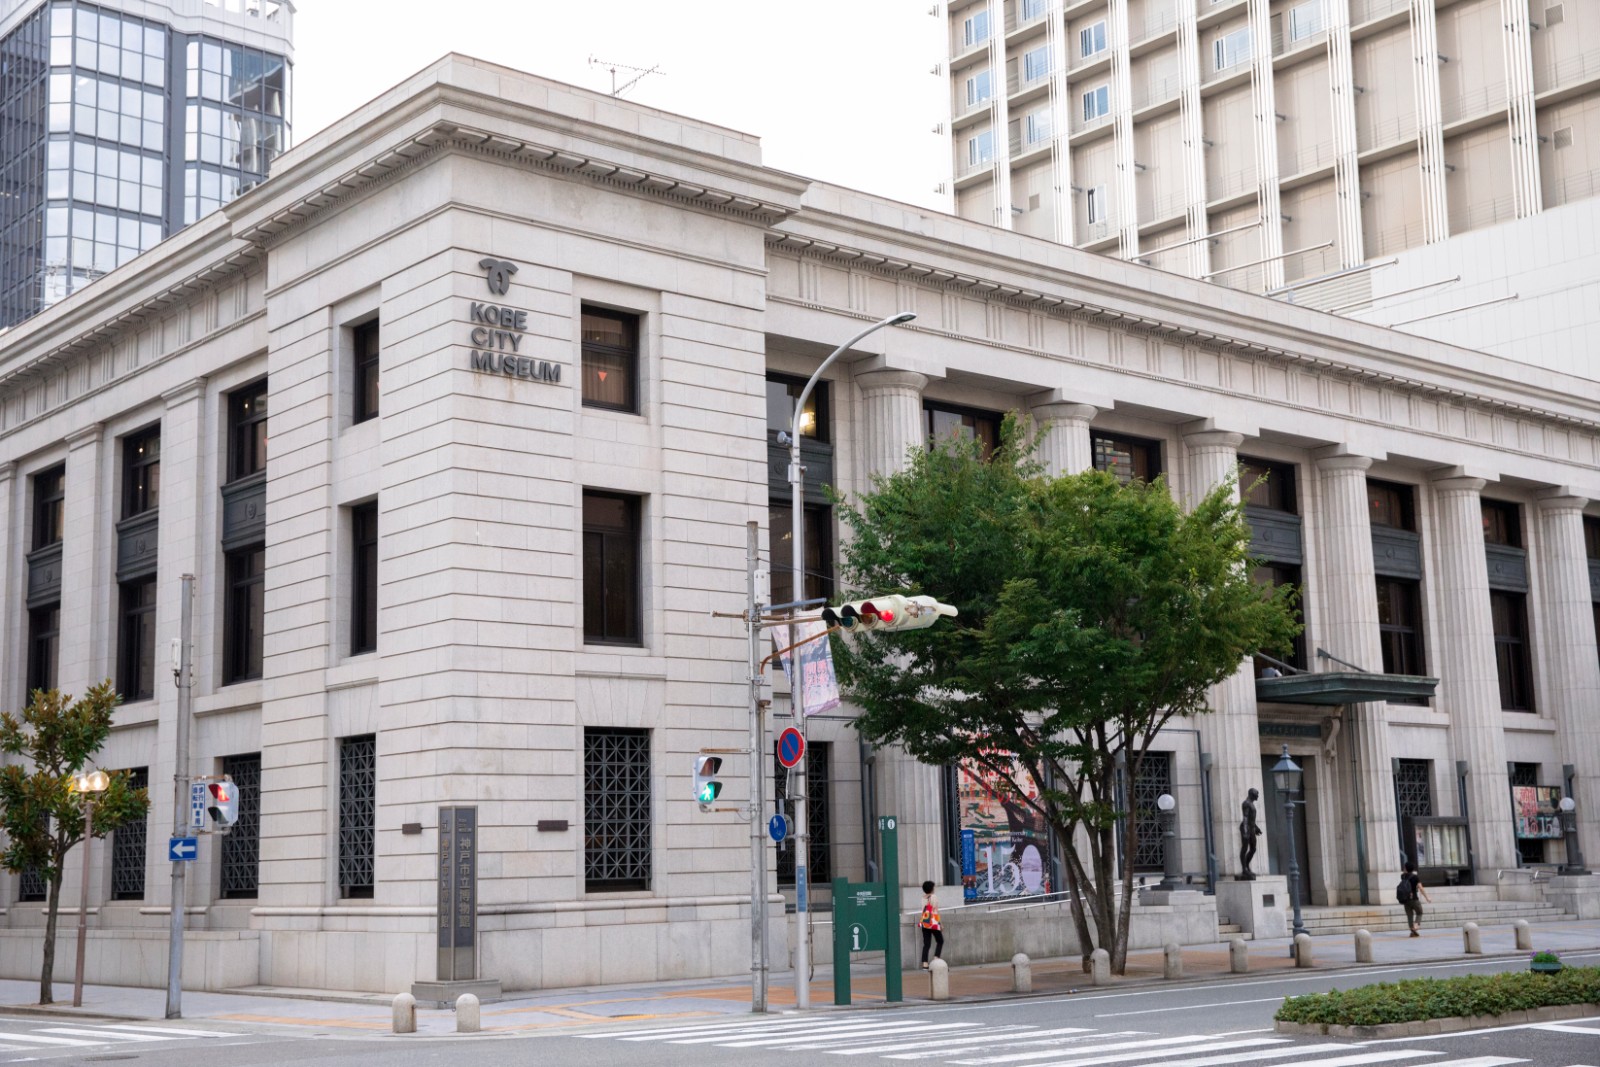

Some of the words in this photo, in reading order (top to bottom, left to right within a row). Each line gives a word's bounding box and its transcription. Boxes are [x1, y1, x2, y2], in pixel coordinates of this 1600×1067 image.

[471, 302, 528, 330] KOBE
[471, 327, 523, 352] CITY
[471, 350, 561, 382] MUSEUM
[459, 837, 471, 928] 神戸市立博物館
